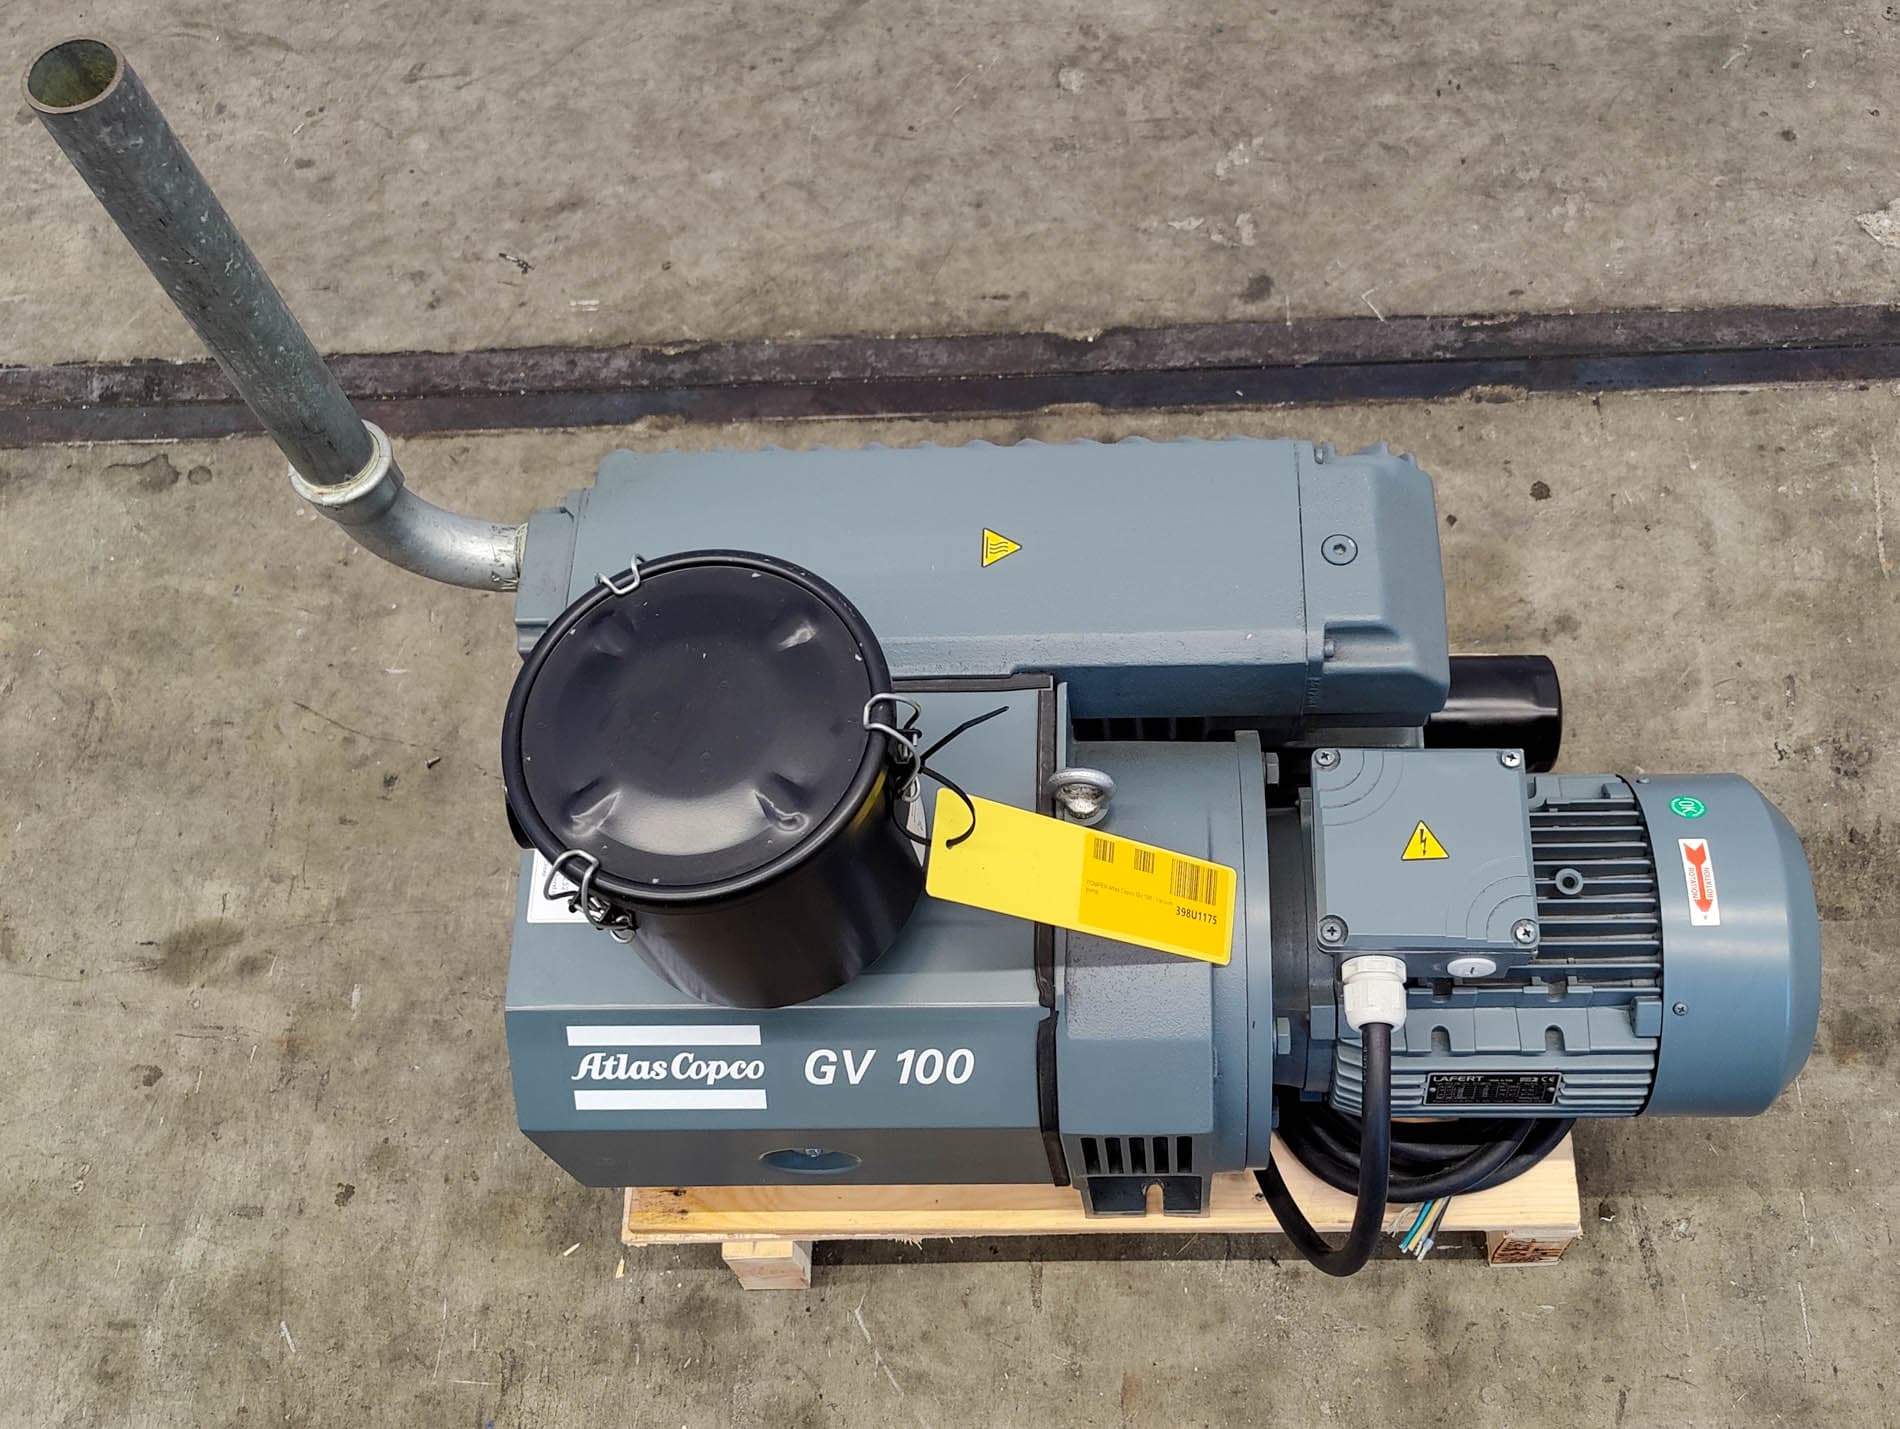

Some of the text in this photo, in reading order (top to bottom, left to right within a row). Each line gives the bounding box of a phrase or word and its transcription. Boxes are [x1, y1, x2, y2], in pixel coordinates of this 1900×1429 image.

[1679, 801, 1698, 813] OK
[1688, 867, 1698, 899] ROTATION
[1704, 867, 1714, 898] ROTATION
[1175, 905, 1217, 925] 398U1175
[571, 1052, 765, 1085] Atlas Copco
[804, 1048, 976, 1085] GV 100
